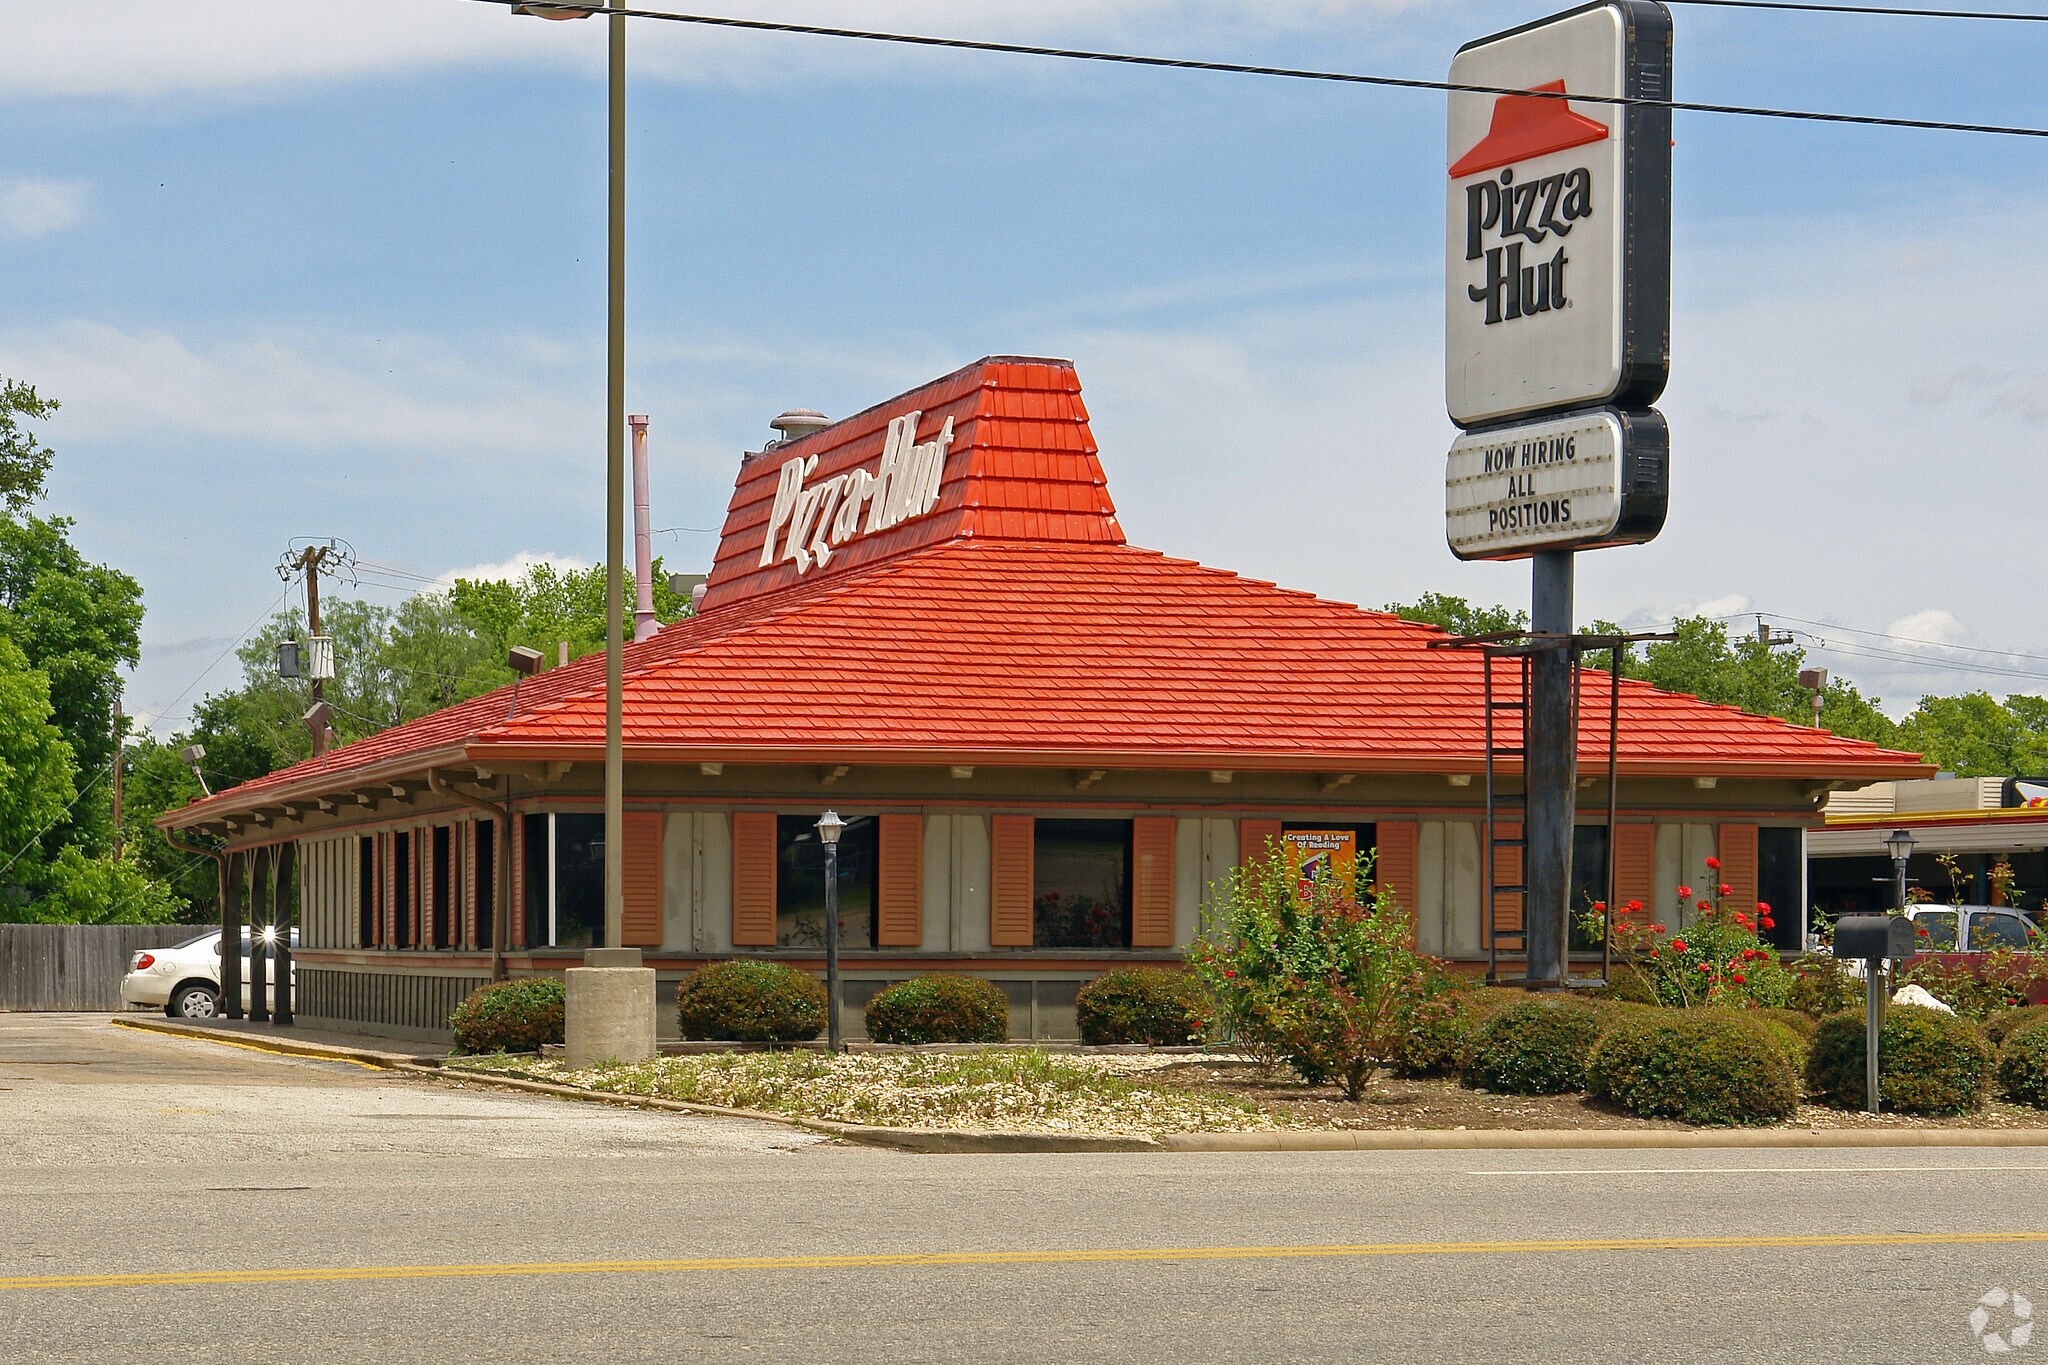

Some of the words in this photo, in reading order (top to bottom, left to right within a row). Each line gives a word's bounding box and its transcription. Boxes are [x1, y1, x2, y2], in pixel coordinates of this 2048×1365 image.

[1466, 167, 1593, 260] Pizza
[1468, 242, 1569, 325] Hut
[1484, 446, 1516, 473] NOW
[1521, 436, 1576, 467] HIRING
[758, 453, 868, 575] Pizza
[862, 410, 955, 535] Hut
[1507, 473, 1536, 499] ALL
[1489, 498, 1571, 532] POSITIONS
[1287, 834, 1322, 842] Creating
[1309, 841, 1340, 850] Reading
